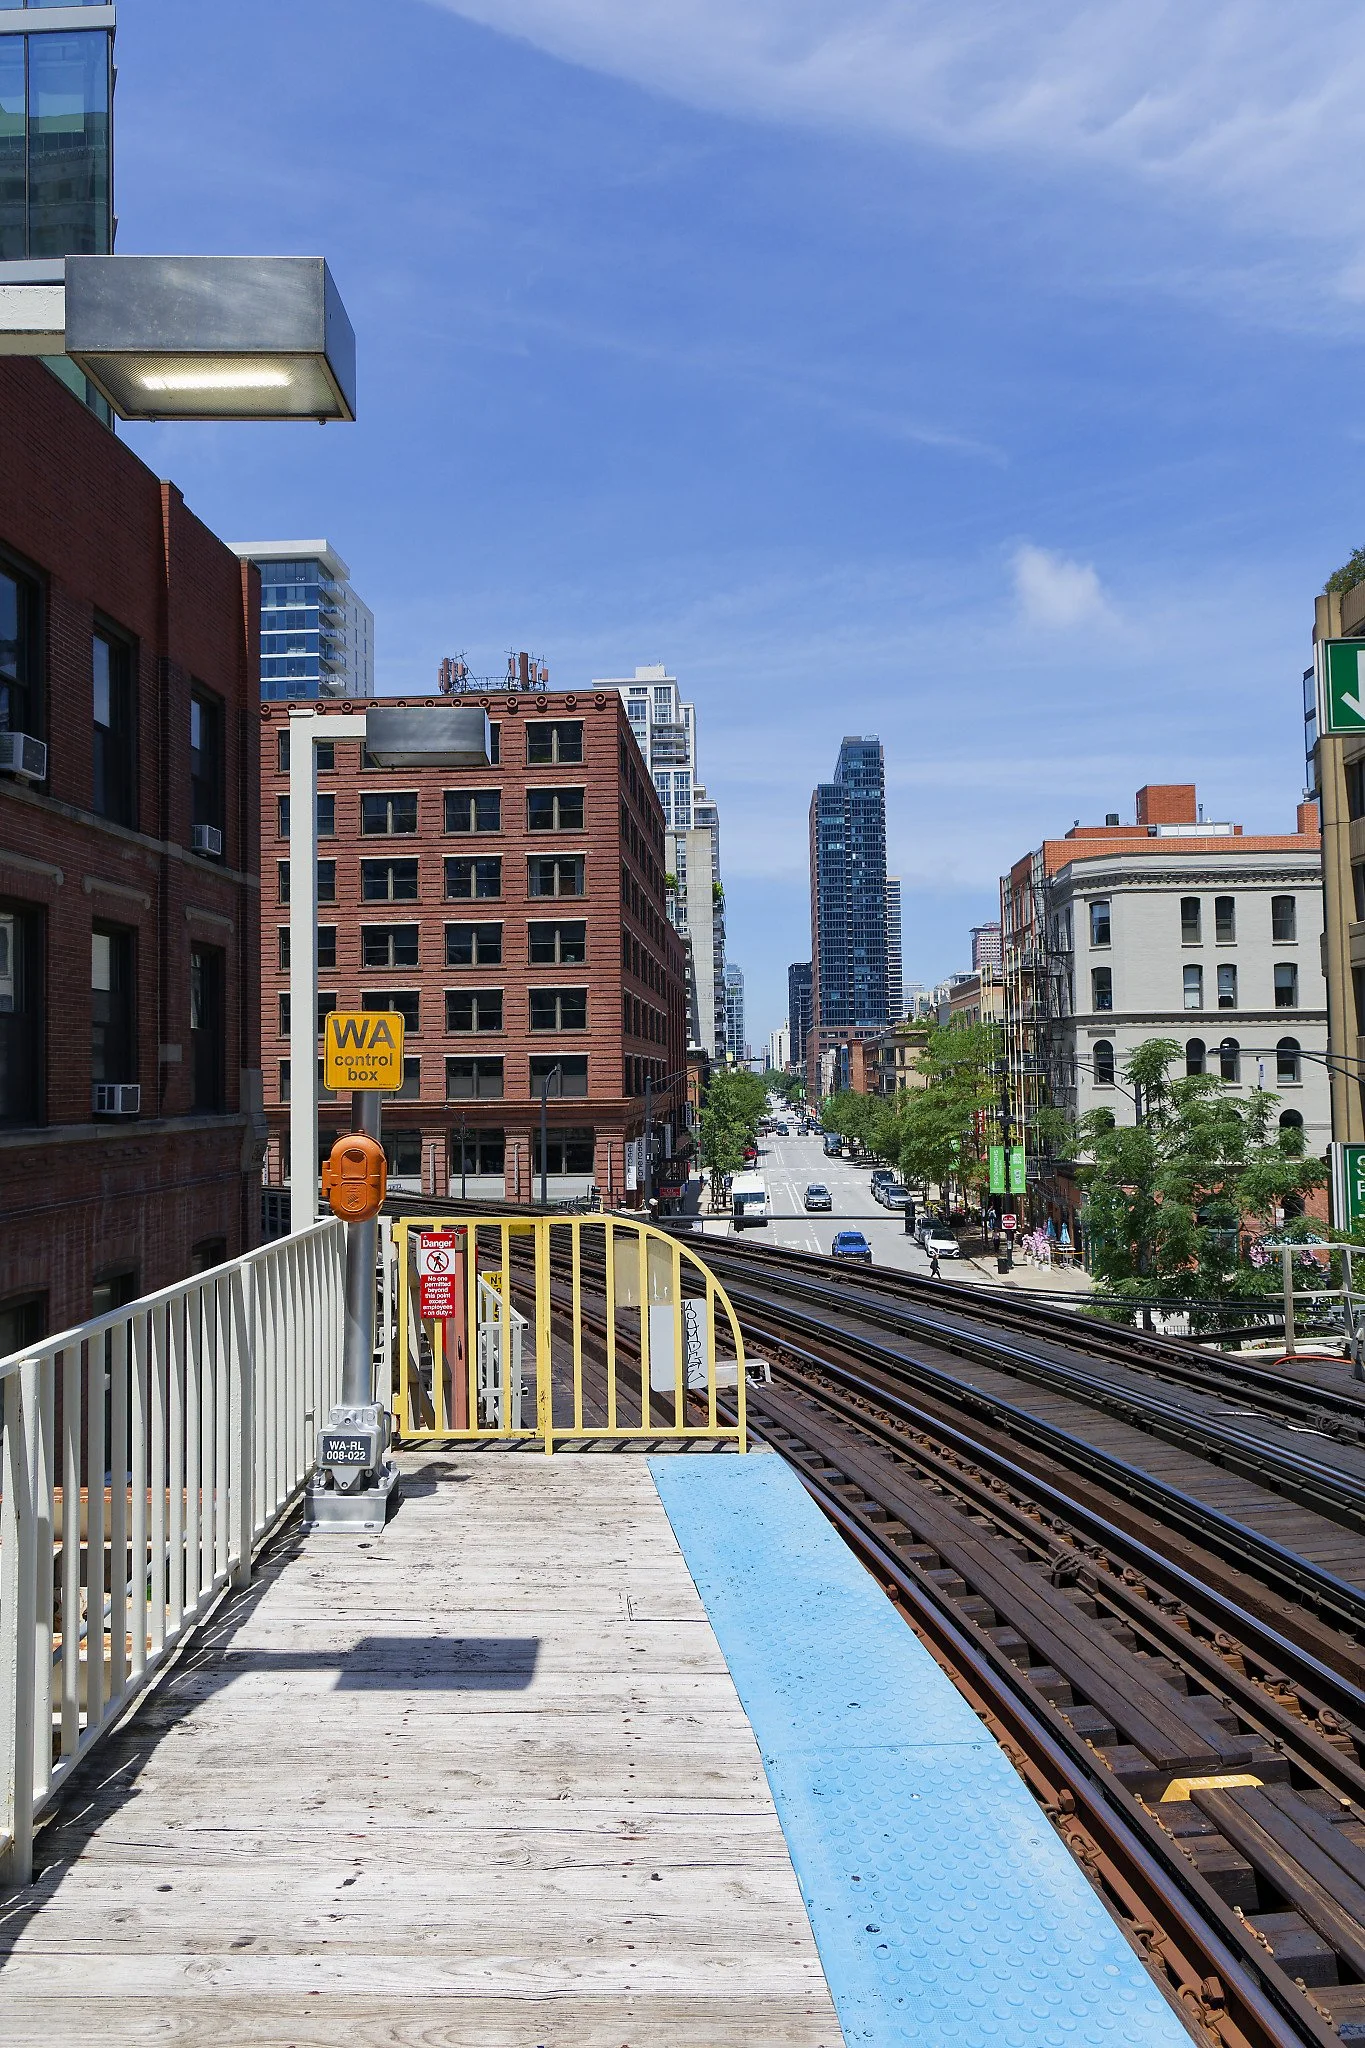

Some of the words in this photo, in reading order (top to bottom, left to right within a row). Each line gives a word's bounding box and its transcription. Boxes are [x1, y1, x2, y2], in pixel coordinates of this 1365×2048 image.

[333, 1019, 396, 1049] WA
[335, 1053, 393, 1066] control
[348, 1068, 378, 1081] box
[423, 1240, 452, 1249] Danger
[329, 1441, 364, 1450] WA-RL
[327, 1451, 366, 1460] 008-022
